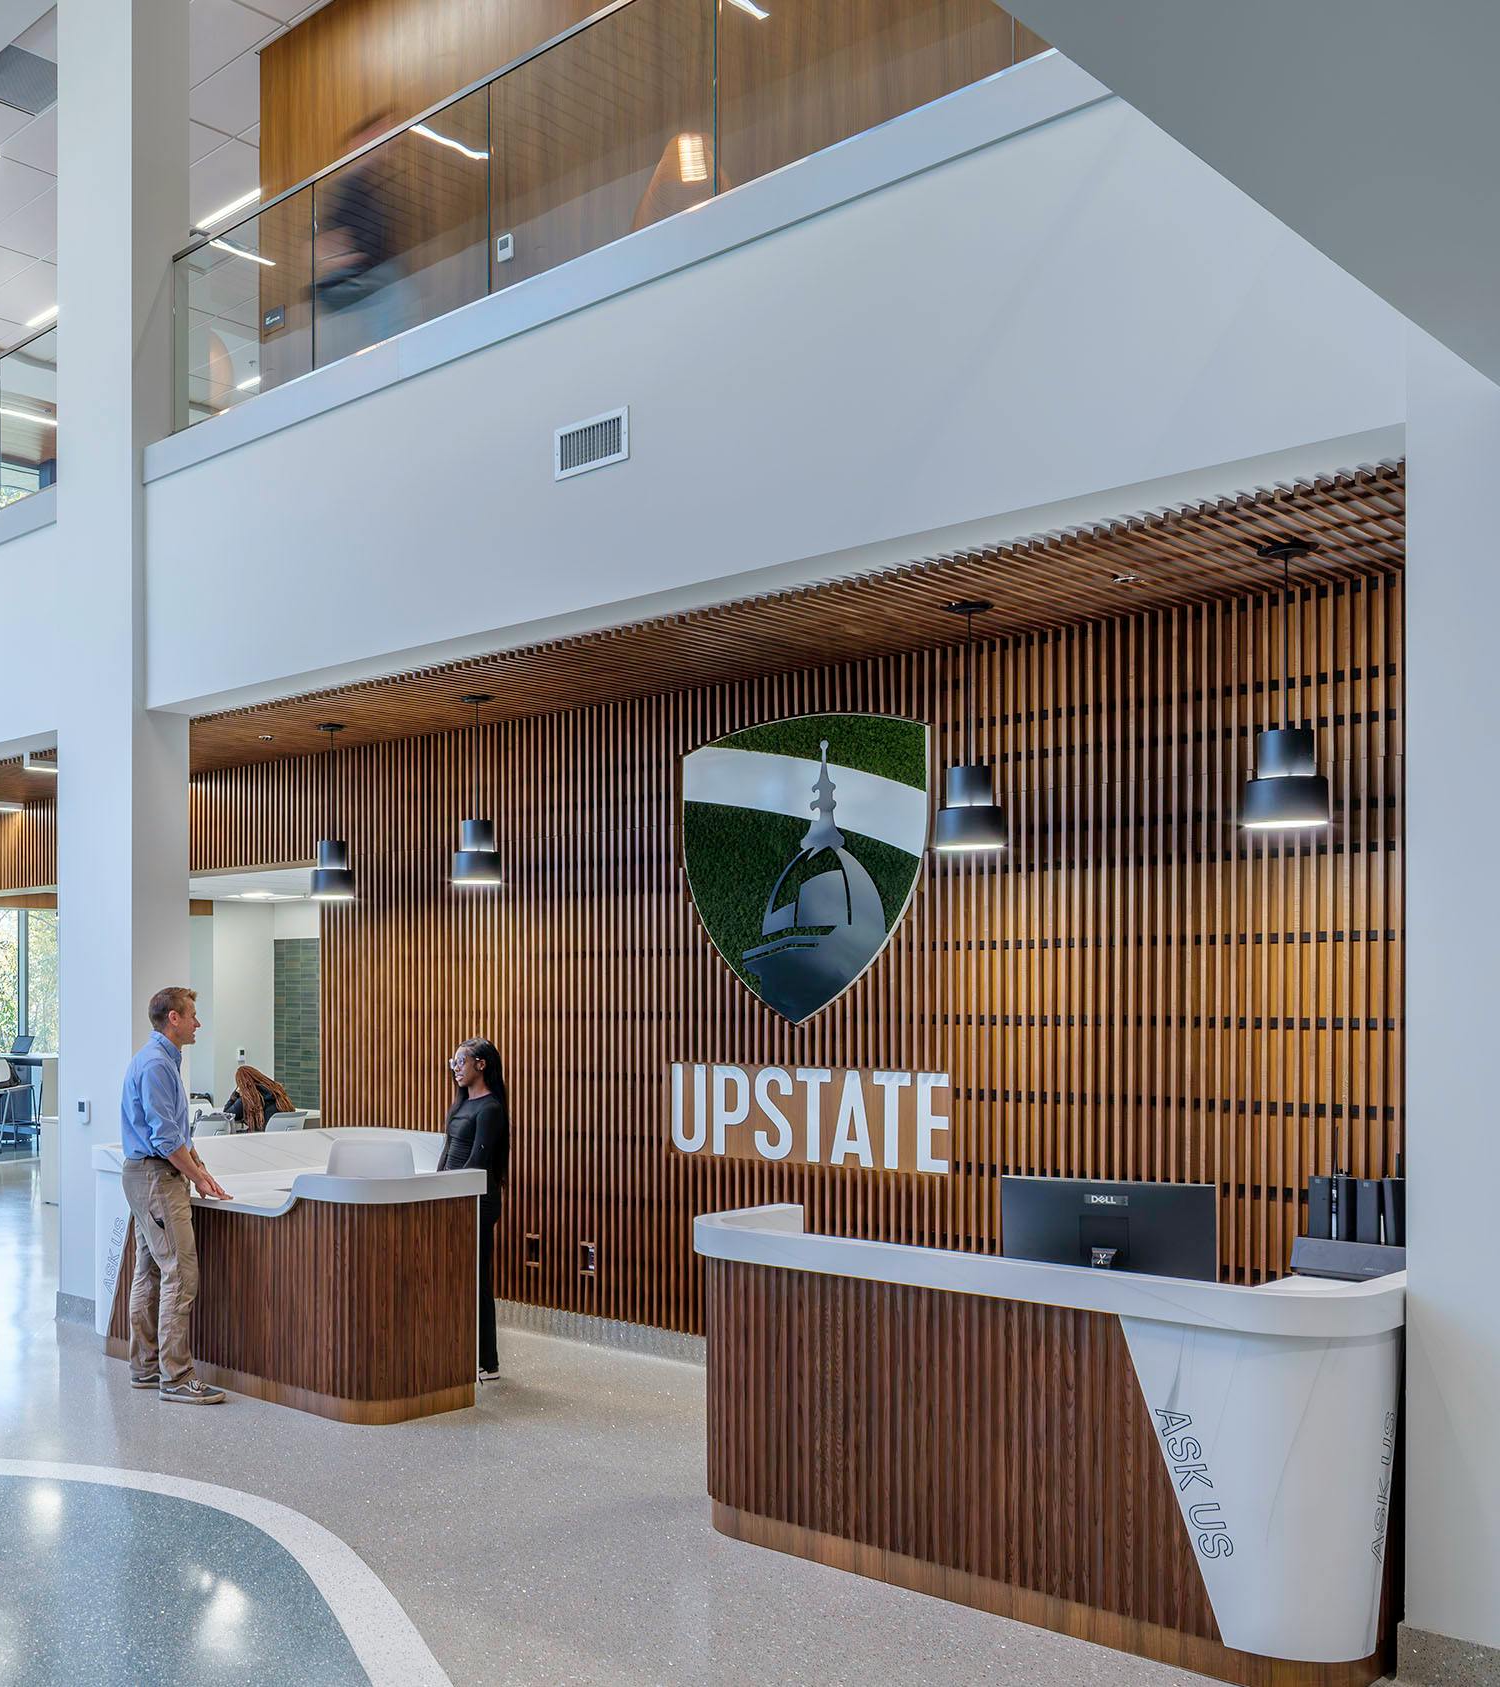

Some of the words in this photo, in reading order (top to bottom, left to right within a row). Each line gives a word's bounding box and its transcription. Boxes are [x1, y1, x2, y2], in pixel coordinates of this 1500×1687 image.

[671, 1063, 949, 1174] UPSTATE
[111, 1217, 126, 1247] US
[1091, 1195, 1117, 1205] DELL
[103, 1248, 120, 1295] ASK
[1155, 1408, 1214, 1492] ASK
[1188, 1502, 1234, 1559] US
[1370, 1477, 1390, 1564] ASK
[1380, 1411, 1396, 1467] US
